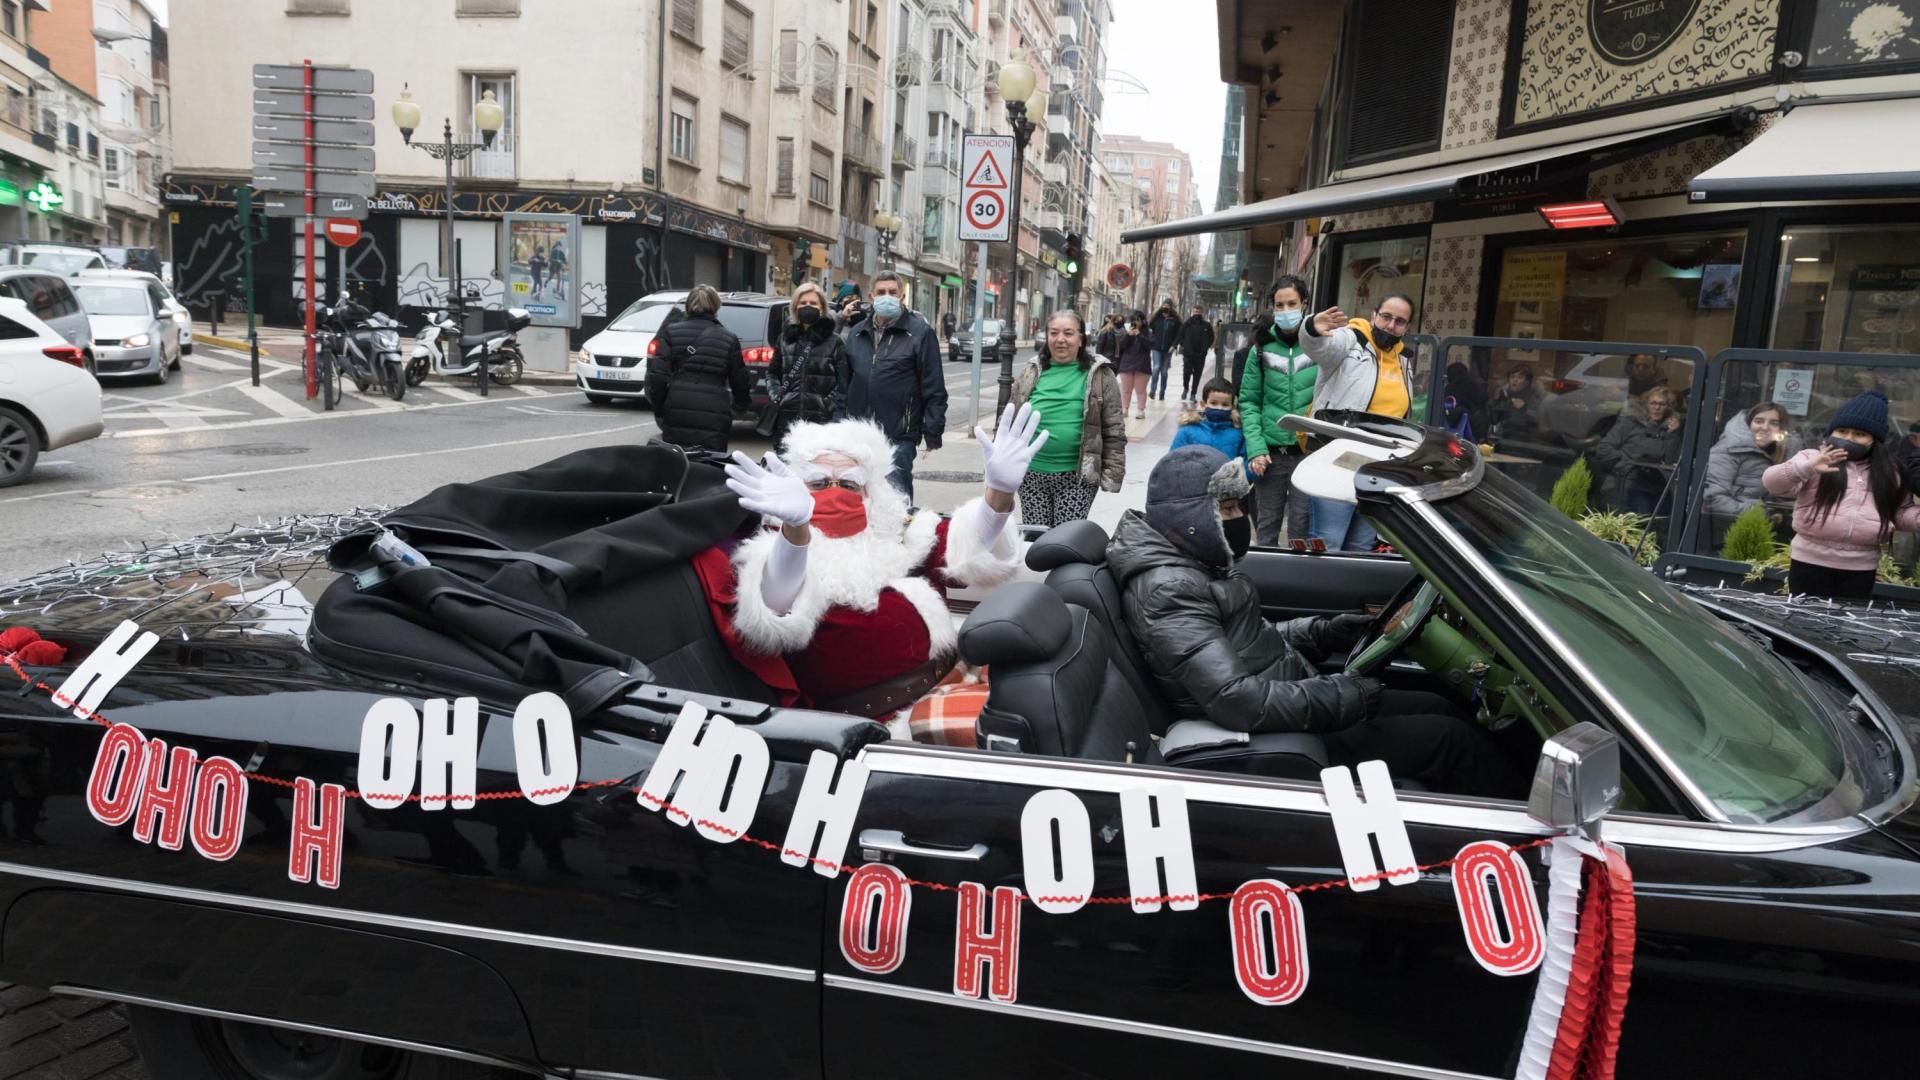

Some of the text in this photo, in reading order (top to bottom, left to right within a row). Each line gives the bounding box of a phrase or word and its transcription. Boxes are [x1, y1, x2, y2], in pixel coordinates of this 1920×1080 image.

[1622, 1, 1665, 21] TUDELA
[378, 200, 416, 210] BELLOTA
[974, 203, 996, 217] 30
[598, 208, 637, 219] Cruzcampo
